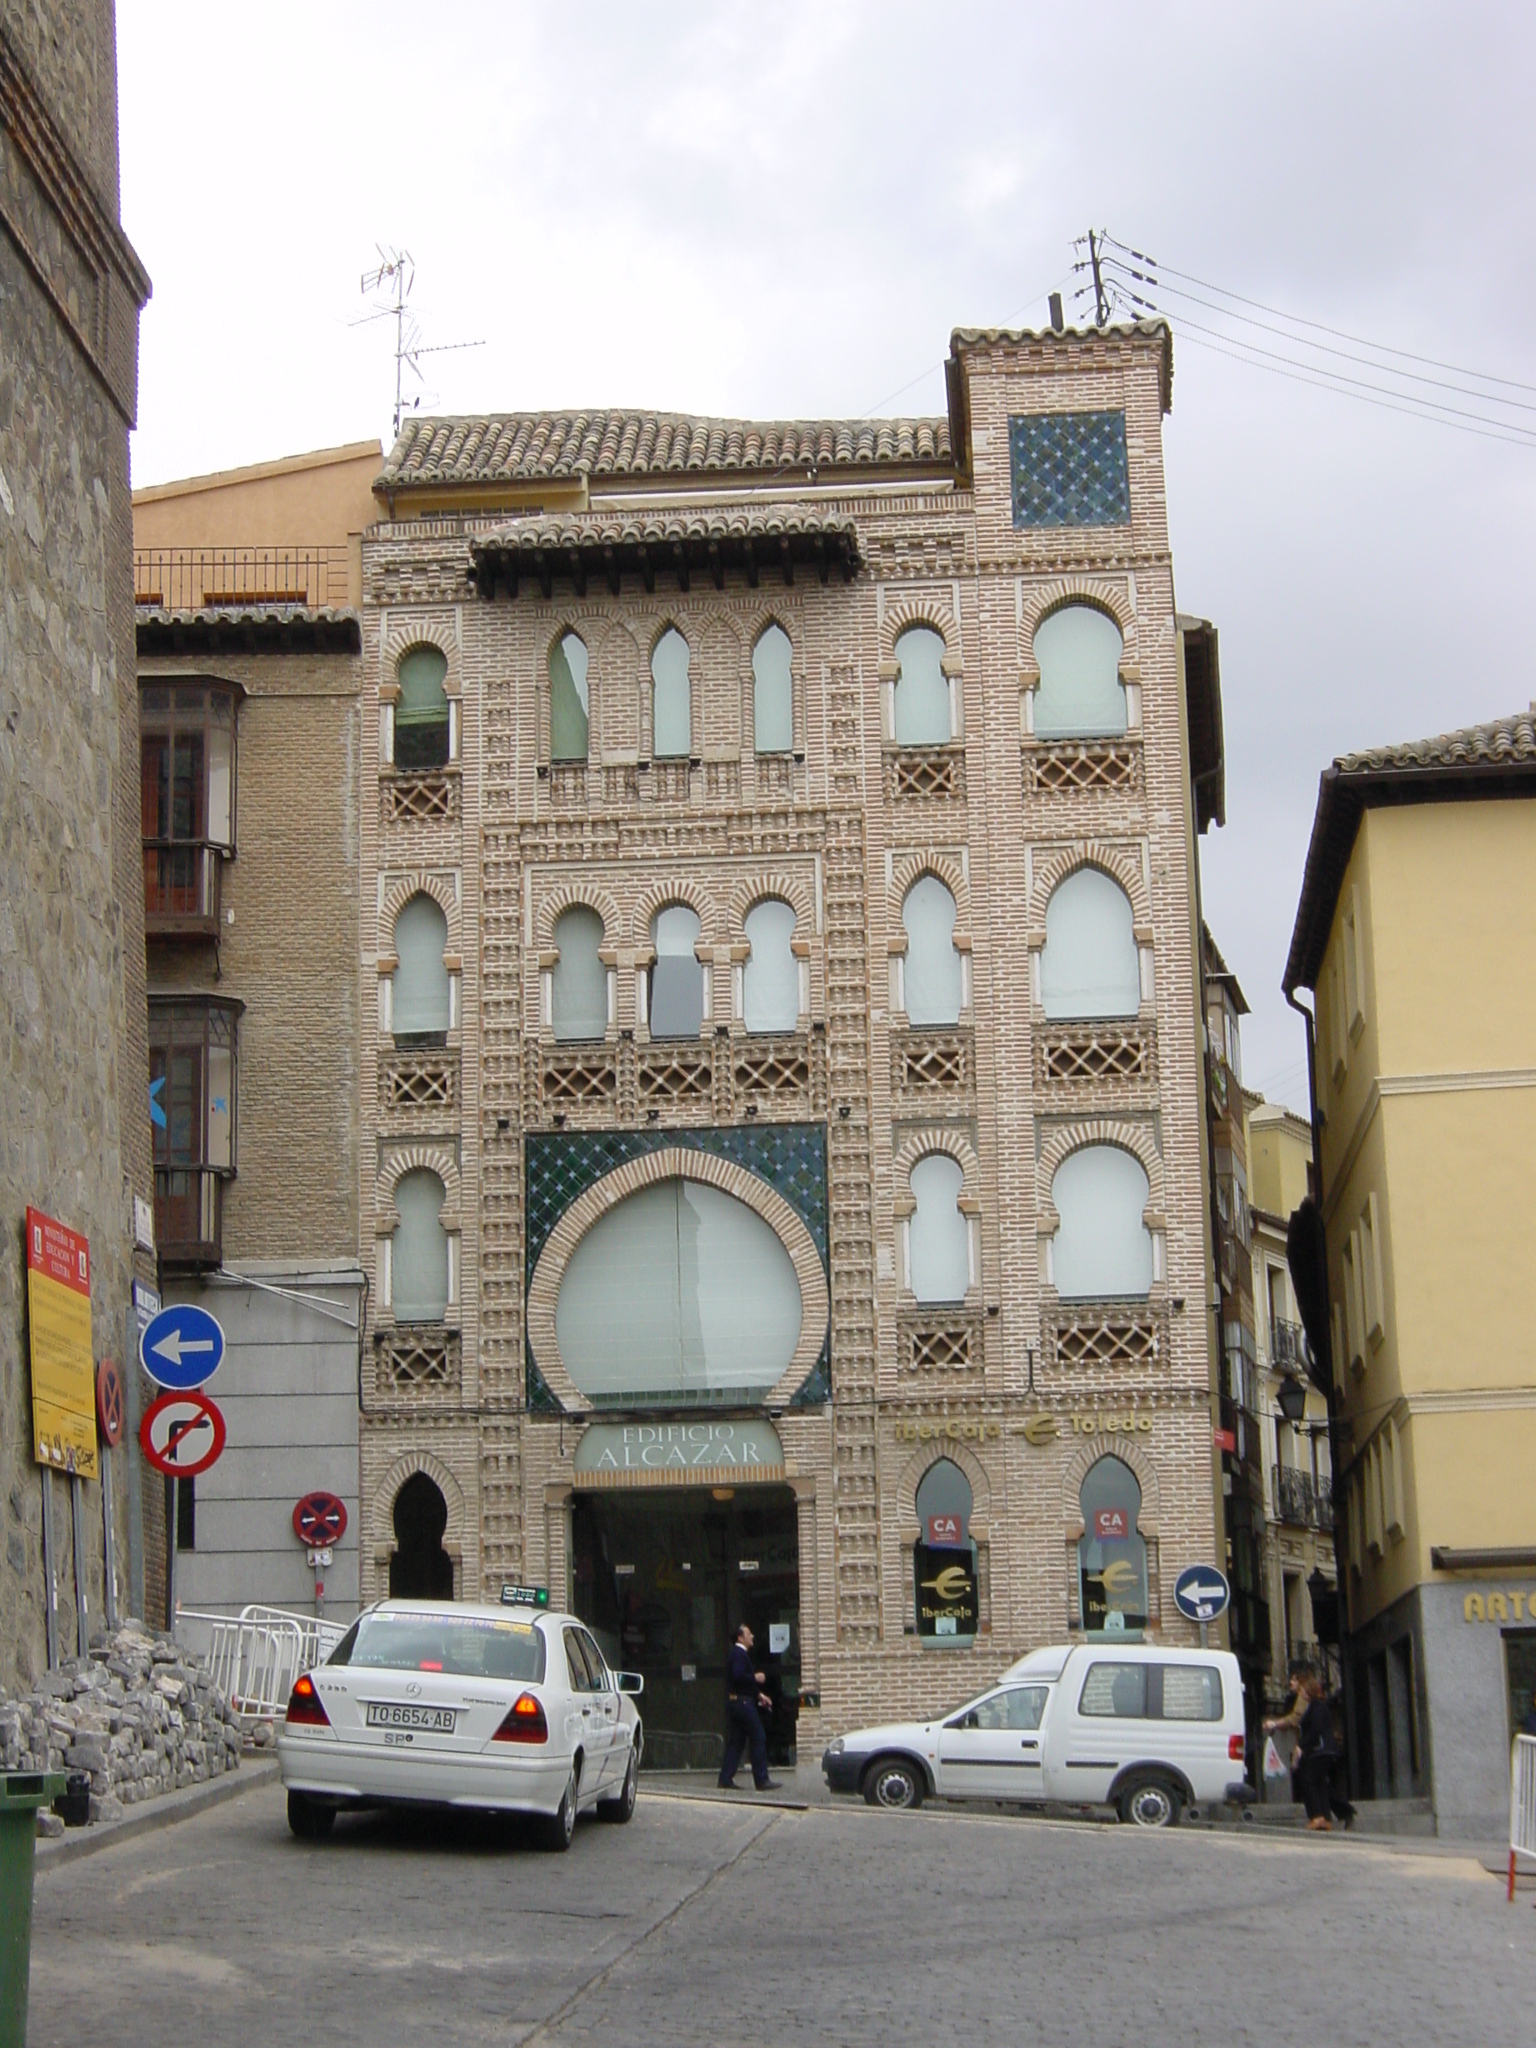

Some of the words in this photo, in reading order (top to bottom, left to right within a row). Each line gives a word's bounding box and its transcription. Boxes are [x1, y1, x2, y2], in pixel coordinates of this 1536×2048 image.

[1070, 1411, 1153, 1433] Toledo
[623, 1425, 735, 1444] EDIFICIO
[597, 1442, 761, 1468] ALCAZAR
[933, 1518, 957, 1532] CA
[1100, 1513, 1123, 1526] CA
[384, 1732, 405, 1745] SP
